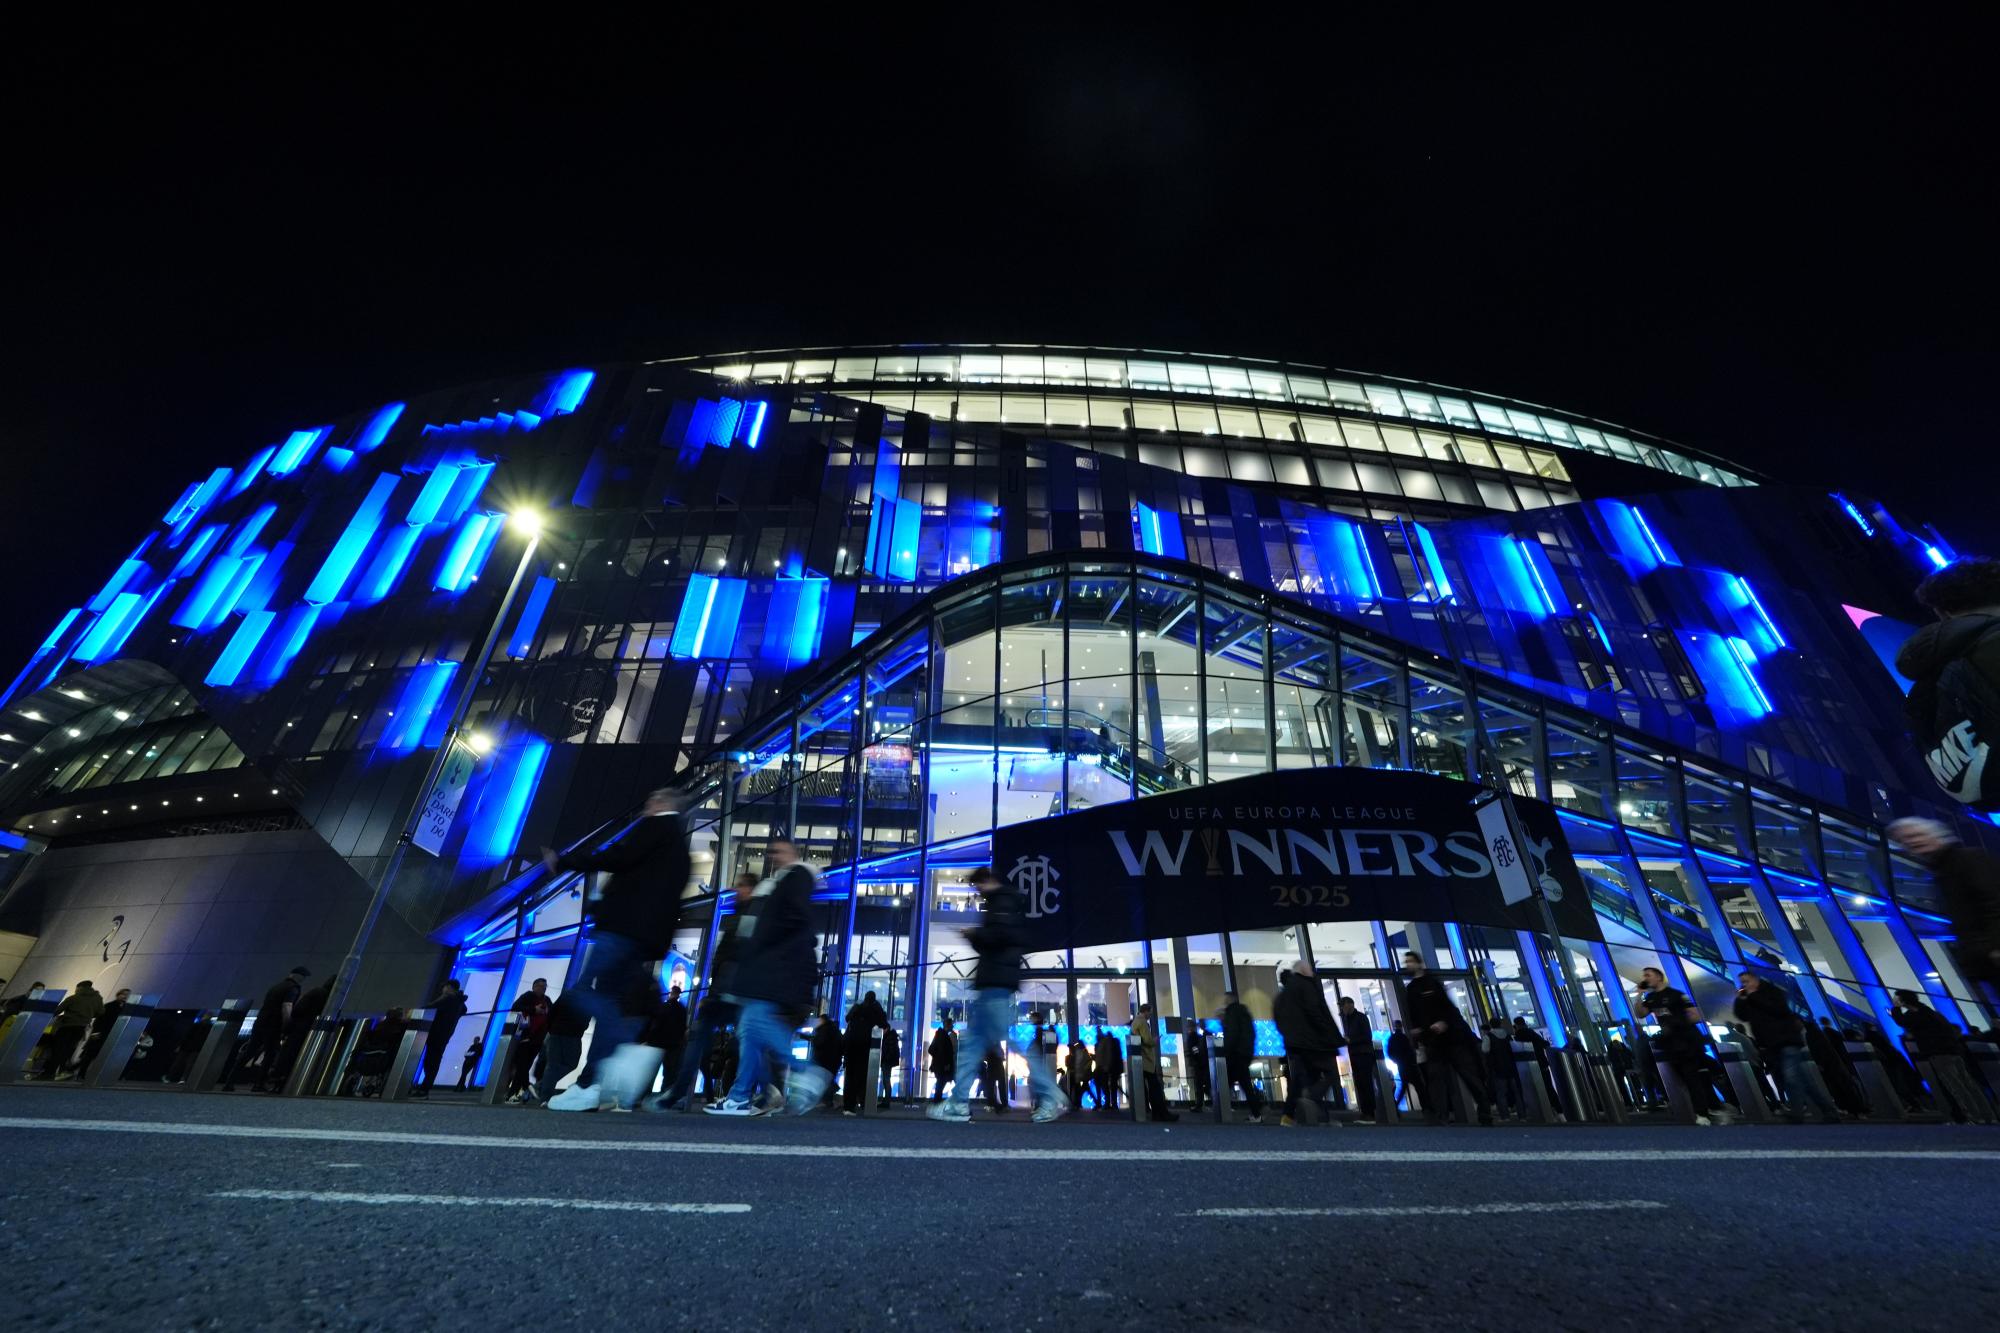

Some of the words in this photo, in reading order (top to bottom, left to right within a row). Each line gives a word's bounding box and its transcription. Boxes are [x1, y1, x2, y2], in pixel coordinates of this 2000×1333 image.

[1925, 719, 1979, 789] NIKE
[433, 788, 446, 799] TO
[433, 813, 445, 825] TO
[1169, 807, 1223, 820] UEFA
[1235, 806, 1321, 819] EUROPA
[1332, 806, 1416, 820] LEAGUE
[431, 825, 445, 837] DO
[1269, 884, 1351, 908] 2025
